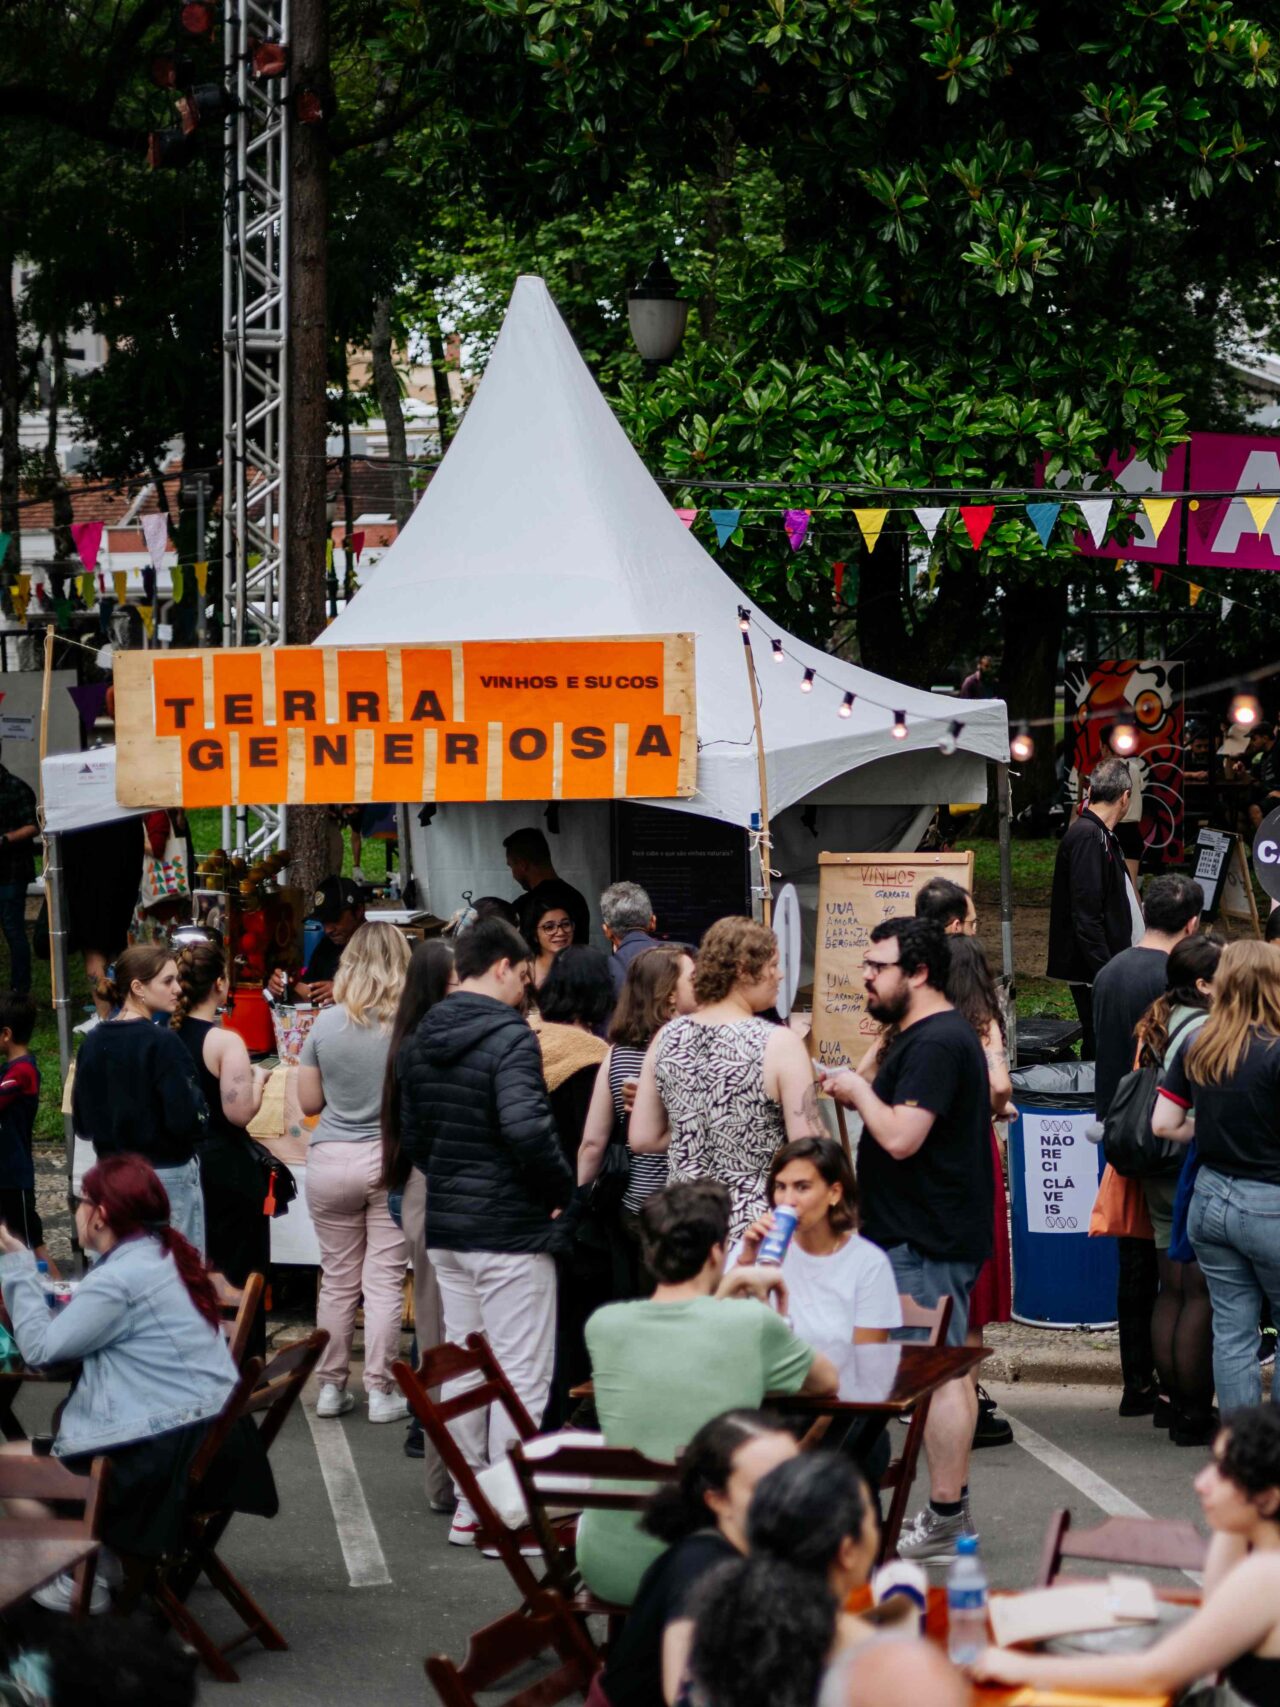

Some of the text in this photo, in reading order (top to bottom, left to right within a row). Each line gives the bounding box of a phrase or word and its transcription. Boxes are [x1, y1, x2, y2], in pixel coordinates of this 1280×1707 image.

[480, 675, 659, 689] VINHOS E SUCOS
[164, 690, 446, 729] TERRA
[188, 725, 672, 771] GENEROSA
[861, 865, 916, 884] VINHOS
[826, 901, 854, 916] UVA
[827, 972, 850, 987] UVA
[825, 1003, 860, 1013] CAPIM
[820, 1040, 841, 1054] UVA
[819, 1055, 851, 1066] AMORA
[1040, 1134, 1075, 1146] NÃO
[1041, 1149, 1061, 1159] RE
[1042, 1161, 1058, 1172] CI
[1043, 1176, 1075, 1189] CLÁ
[1043, 1191, 1063, 1201] VE
[1045, 1204, 1061, 1215] IS
